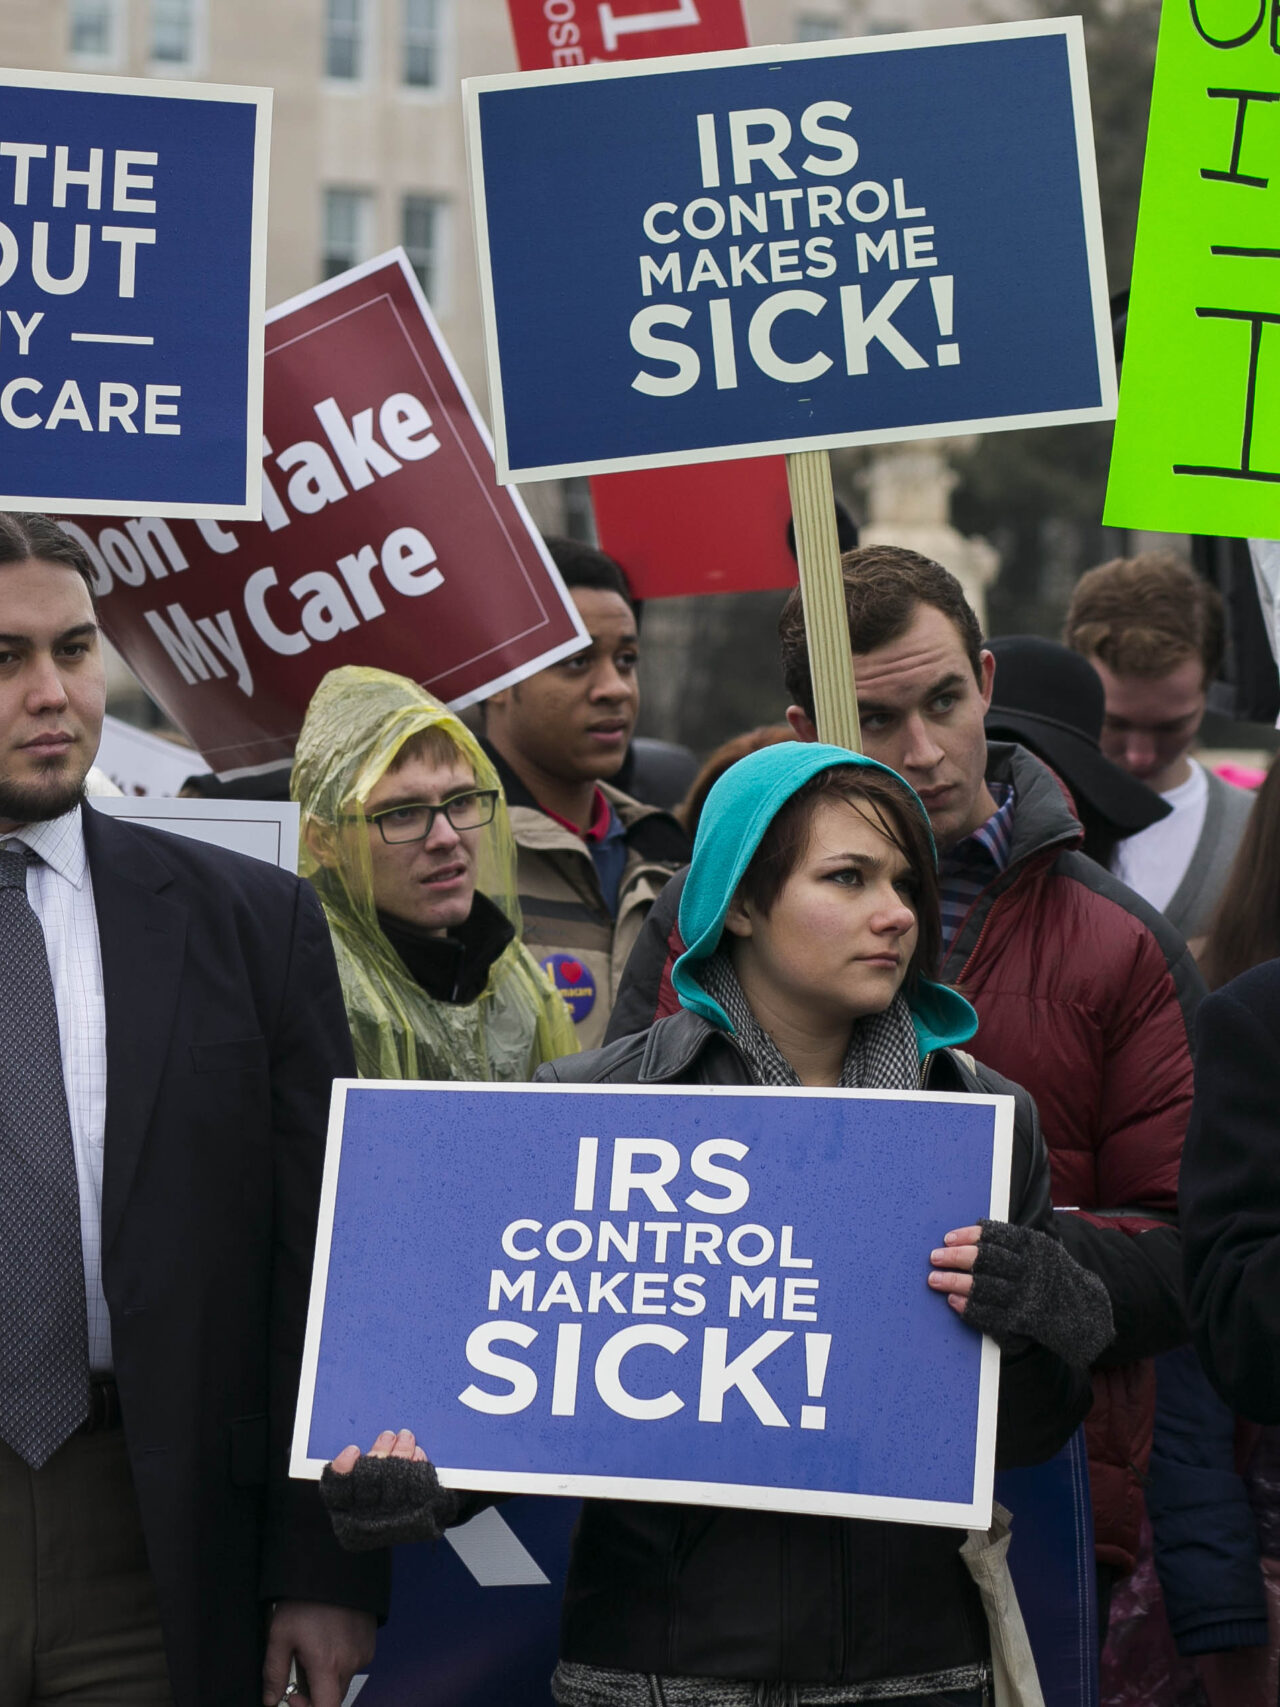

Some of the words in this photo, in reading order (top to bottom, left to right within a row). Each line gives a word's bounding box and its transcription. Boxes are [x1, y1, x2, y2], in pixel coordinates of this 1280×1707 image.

[0, 141, 159, 214] THE
[697, 100, 859, 188] IRS
[642, 178, 926, 244] CONTROL
[639, 236, 838, 297] MAKES
[855, 225, 938, 274] ME
[629, 274, 961, 397] SICK!
[0, 377, 182, 436] CARE
[143, 602, 254, 698] My
[243, 526, 445, 656] Care
[573, 1136, 750, 1215] IRS
[501, 1218, 813, 1269] CONTROL
[488, 1269, 706, 1316] MAKES
[728, 1275, 819, 1322] ME
[457, 1320, 832, 1430] SICK!
